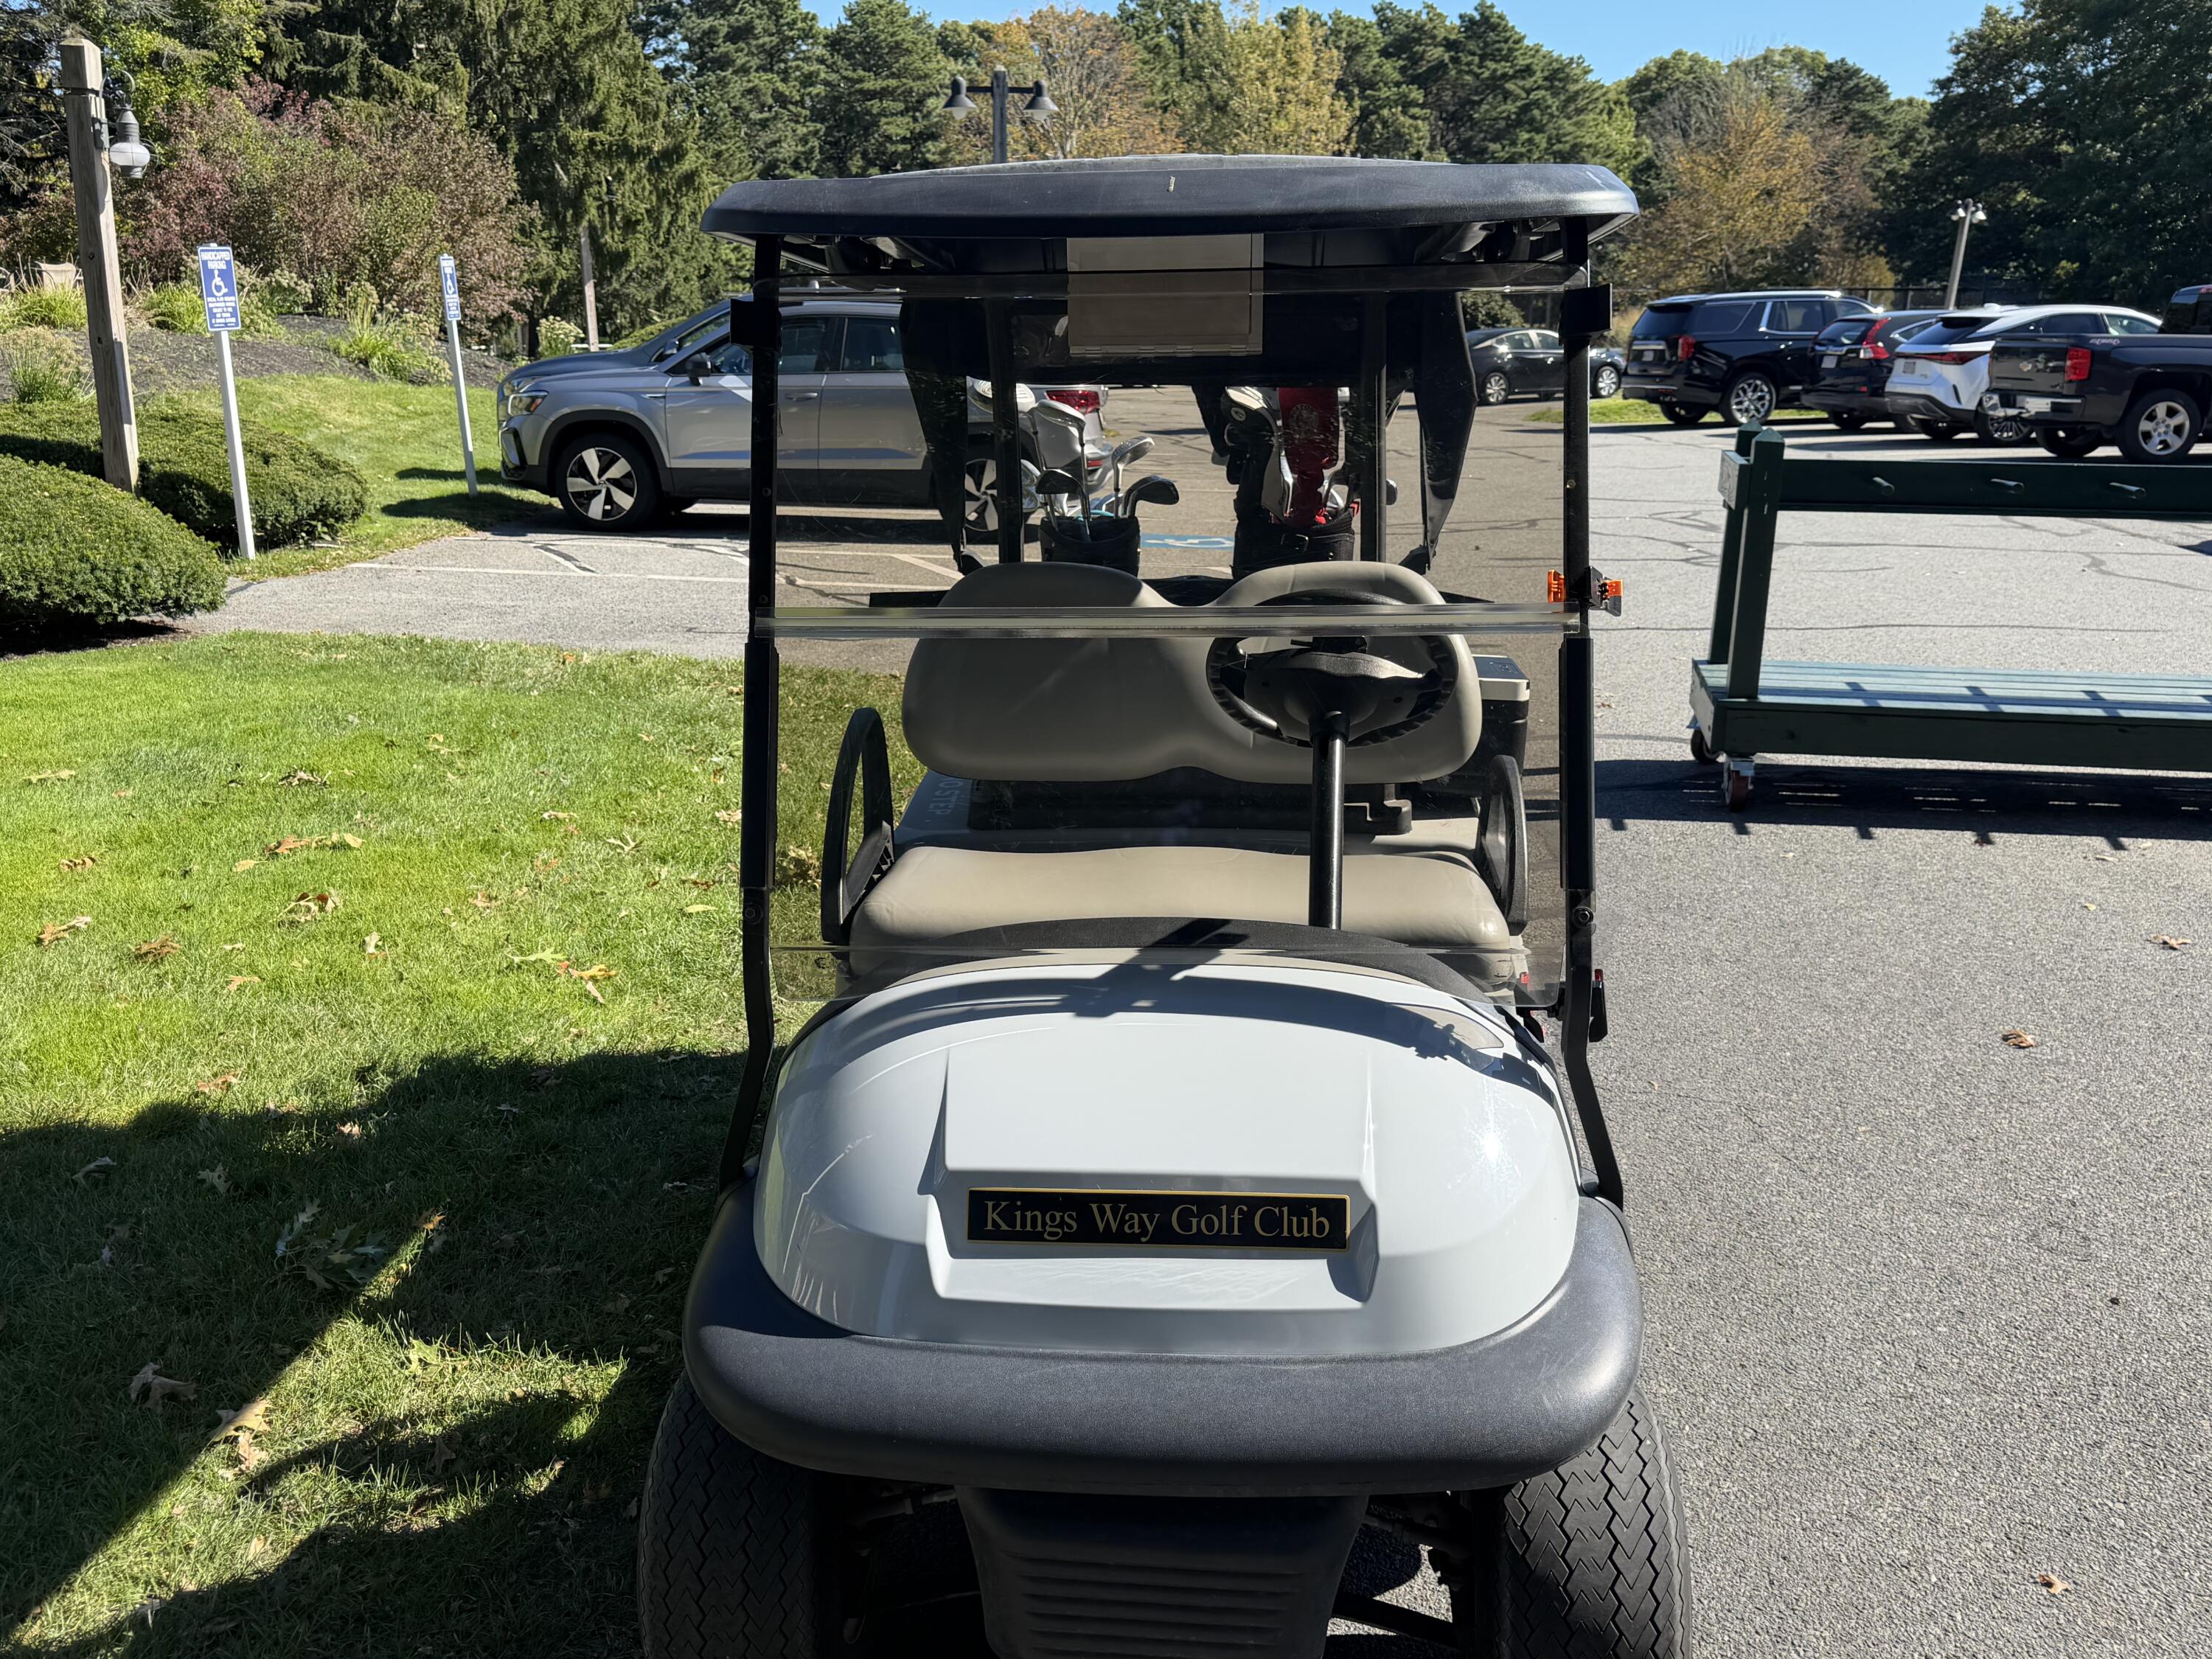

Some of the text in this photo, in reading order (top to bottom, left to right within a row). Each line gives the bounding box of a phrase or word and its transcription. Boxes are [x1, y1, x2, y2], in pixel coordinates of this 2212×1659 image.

[201, 251, 231, 261] HANDICAPPED
[207, 260, 227, 269] PARKING
[928, 790, 960, 815] STEP
[984, 1200, 1330, 1242] Kings Way Golf Club
